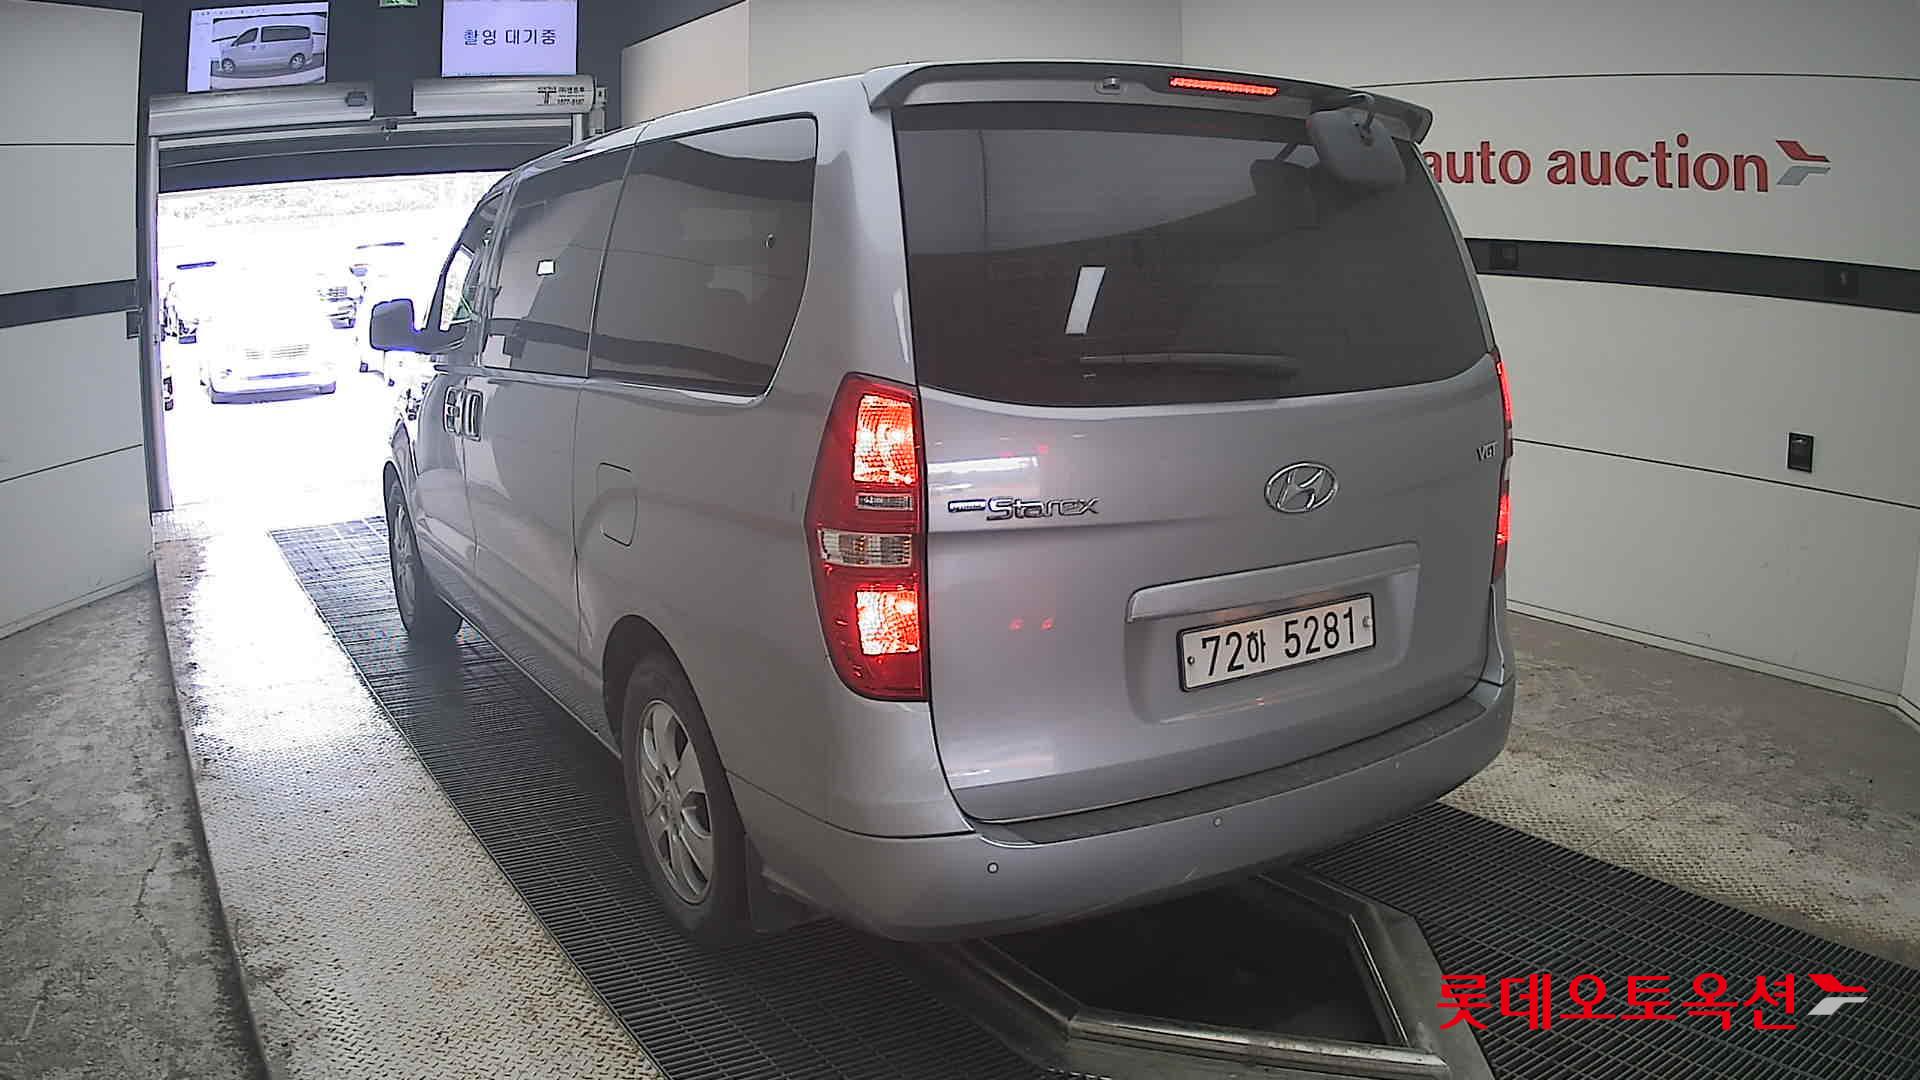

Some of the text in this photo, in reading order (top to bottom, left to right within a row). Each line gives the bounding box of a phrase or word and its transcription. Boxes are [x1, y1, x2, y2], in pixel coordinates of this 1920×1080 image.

[505, 29, 555, 46] 대기중
[1422, 133, 1768, 193] auto auction
[1475, 441, 1497, 461] VGT
[986, 497, 1099, 521] Starex
[1201, 606, 1354, 677] 72하 5281
